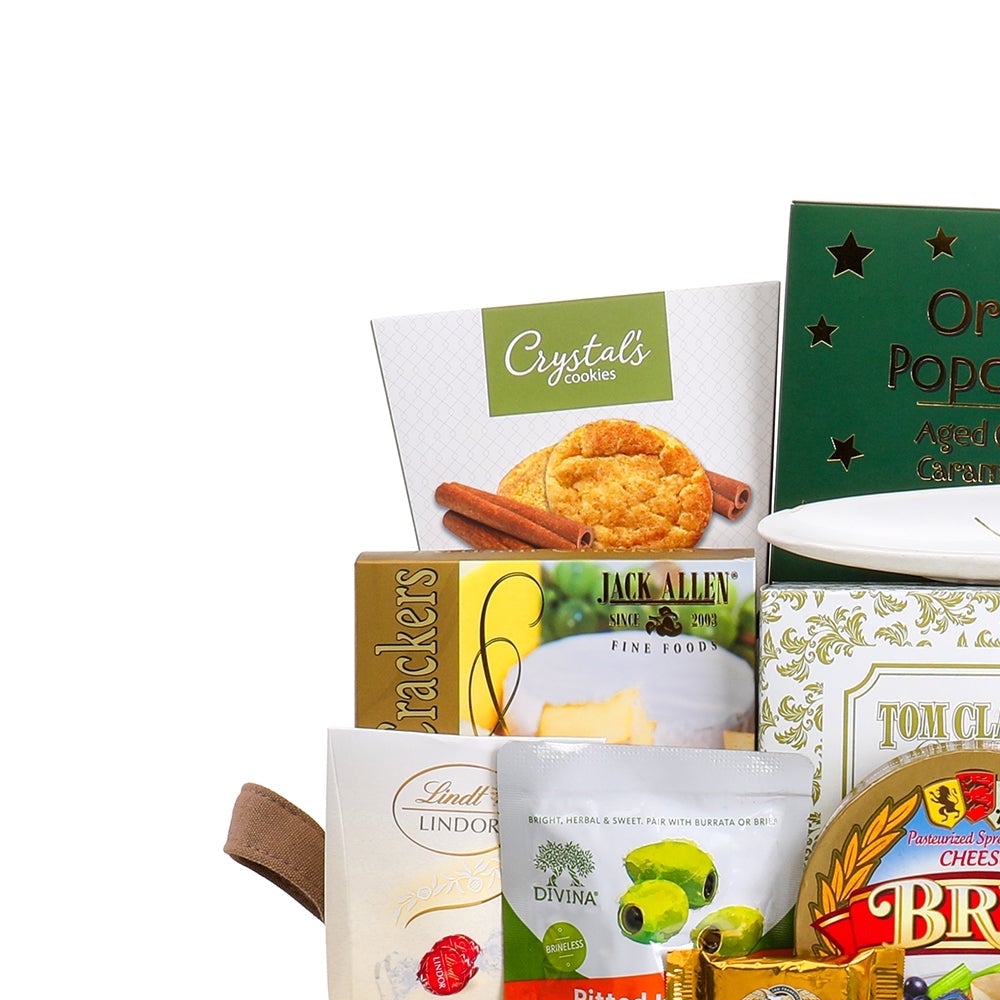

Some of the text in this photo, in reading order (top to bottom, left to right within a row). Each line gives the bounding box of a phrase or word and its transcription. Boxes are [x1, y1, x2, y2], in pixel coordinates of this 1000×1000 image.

[504, 329, 651, 386] Crystal's
[564, 367, 617, 385] cookies
[914, 419, 988, 454] Aged
[597, 571, 730, 604] JACK ALLEN
[609, 613, 717, 627] SINCE 2003
[375, 568, 438, 734] rackers
[611, 640, 718, 654] FINE FOODS
[877, 701, 950, 749] TOM
[415, 781, 490, 806] Lindt
[420, 815, 499, 834] LINDOR
[528, 815, 564, 826] BRIGHT,
[566, 816, 601, 825] HERBAL
[603, 816, 610, 825] &
[613, 816, 643, 825] SWEET.
[647, 817, 666, 826] PAIR
[668, 818, 692, 826] WITH
[695, 818, 735, 827] BURRATA
[738, 818, 751, 826] OR
[907, 829, 974, 847] Pasteurized
[534, 886, 597, 906] DIVINA
[546, 939, 584, 954] BRINELESS
[433, 956, 447, 989] LINDOR
